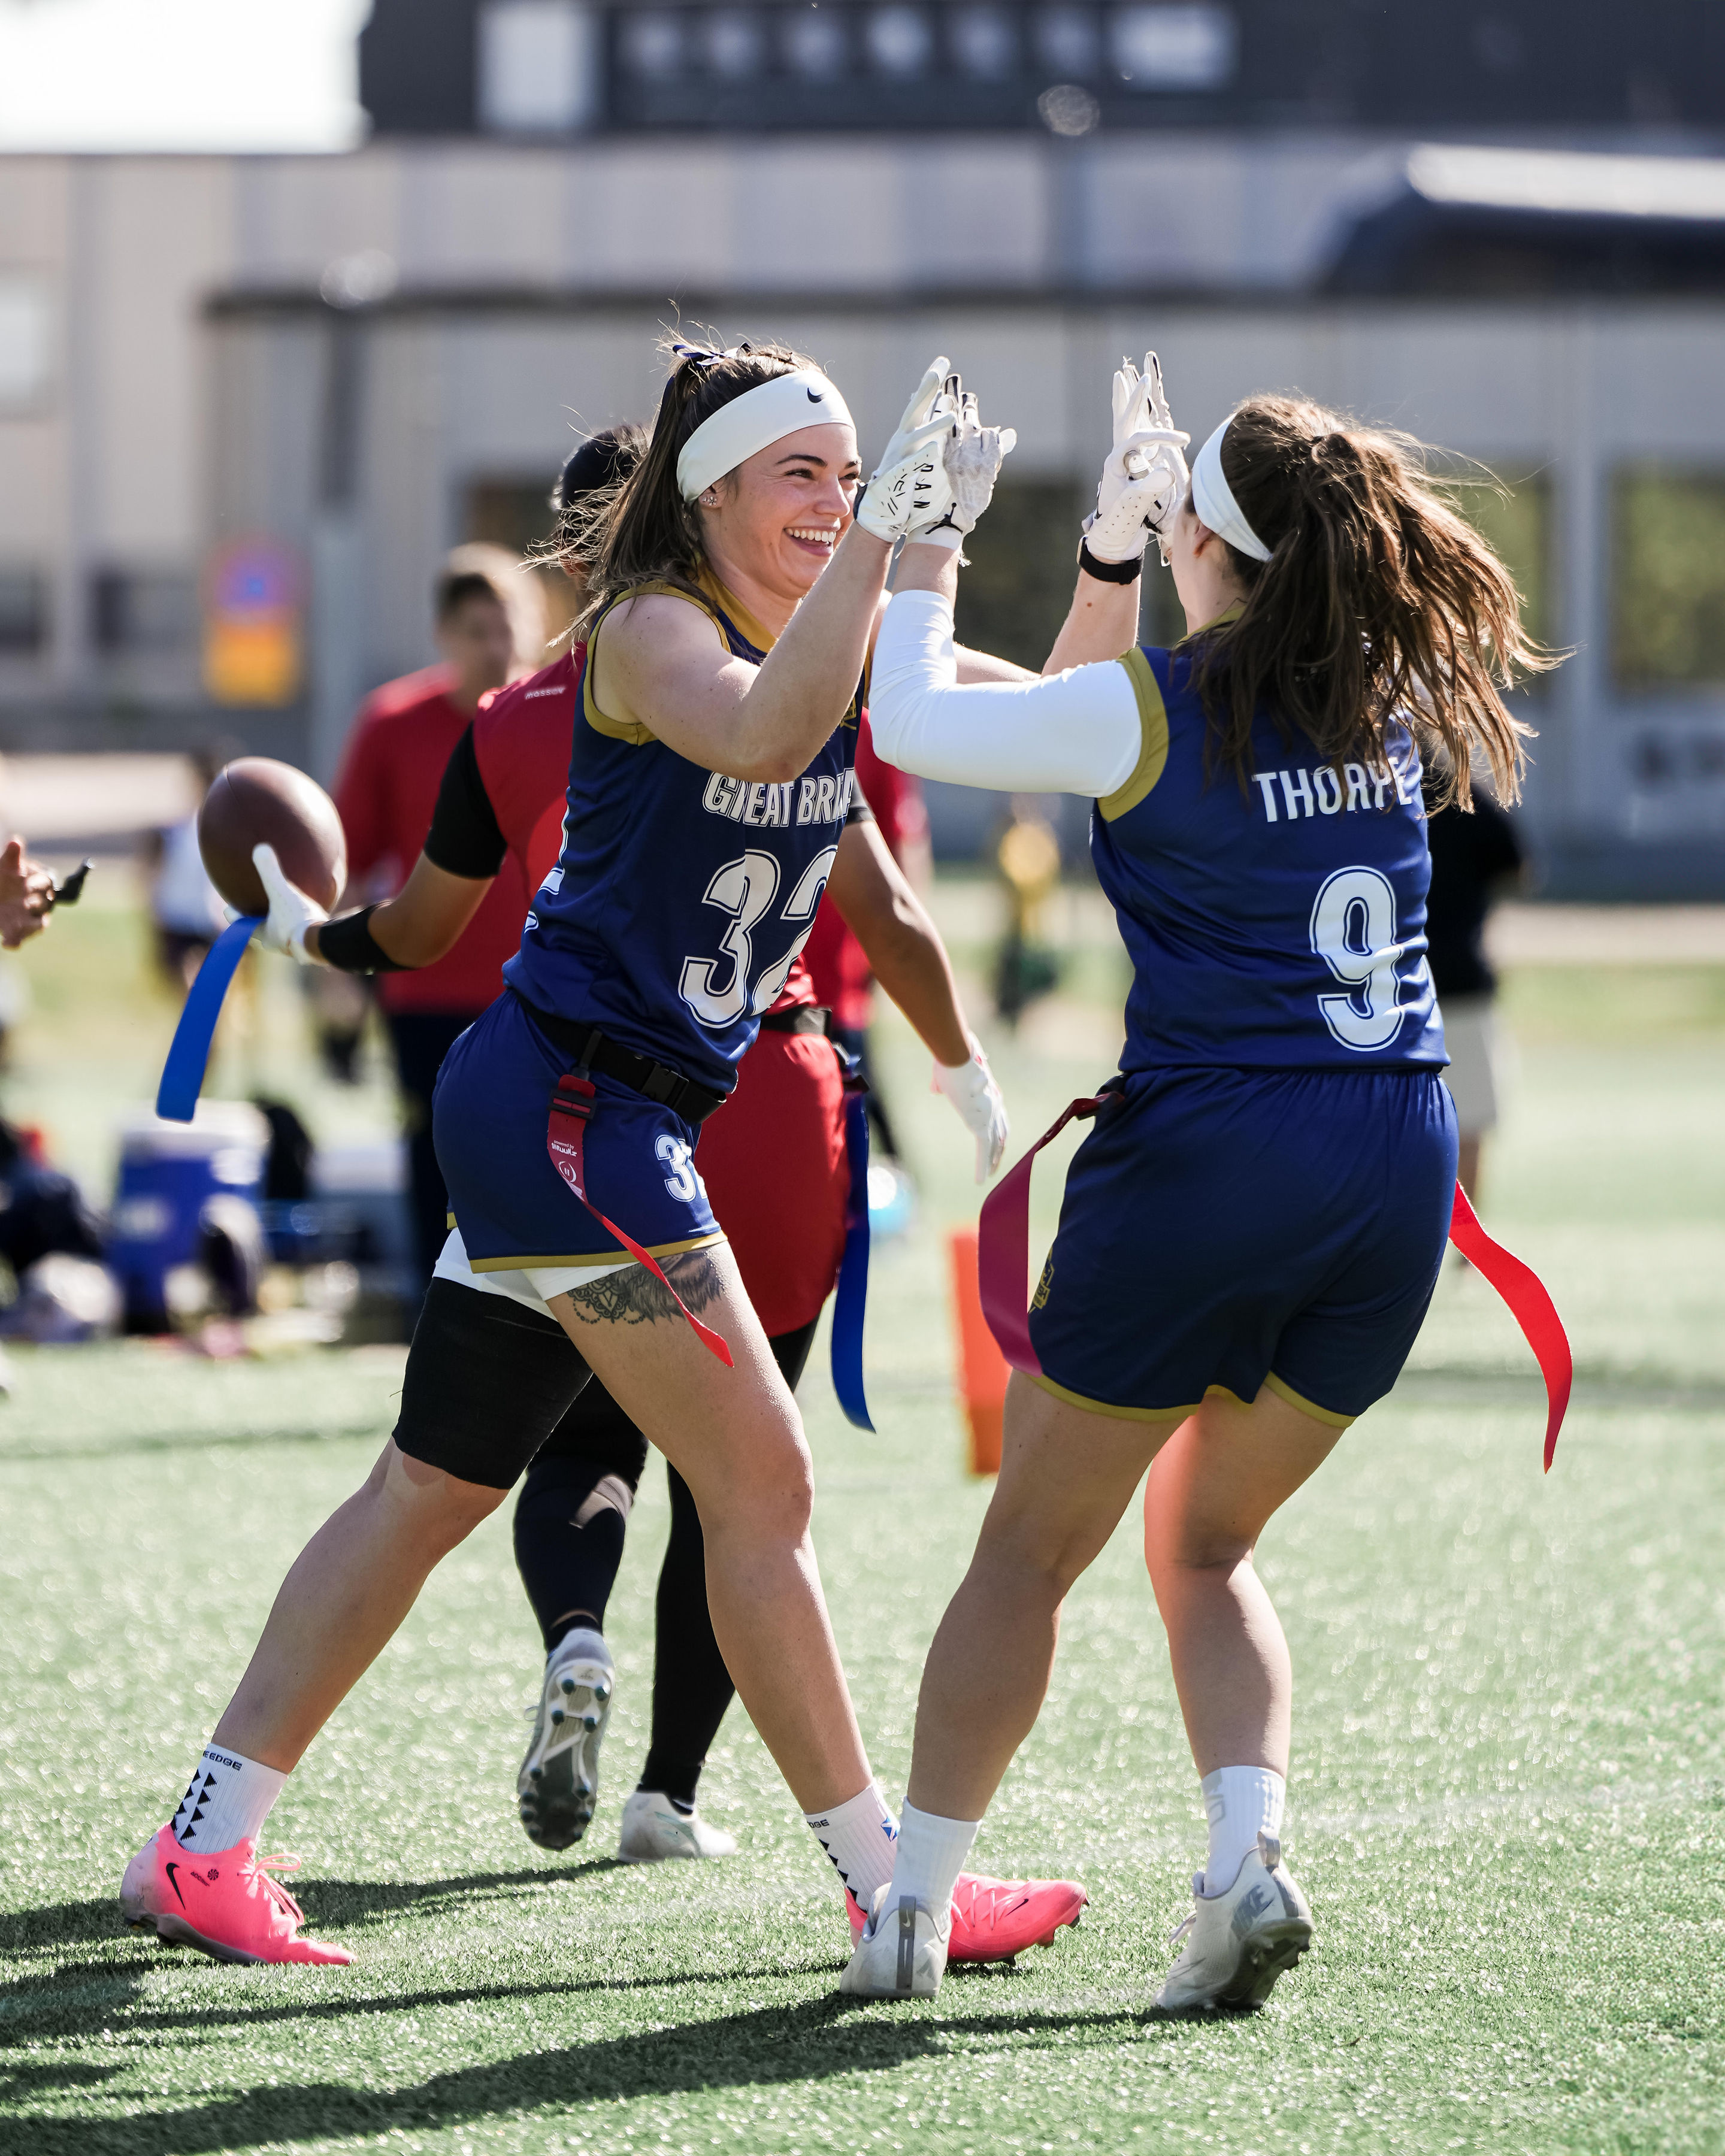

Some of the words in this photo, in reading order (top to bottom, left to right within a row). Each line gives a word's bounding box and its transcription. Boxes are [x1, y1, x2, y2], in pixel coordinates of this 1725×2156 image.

[1252, 756, 1412, 822] THORPE
[1309, 865, 1405, 1052] 9
[807, 1819, 830, 1828] DGE
